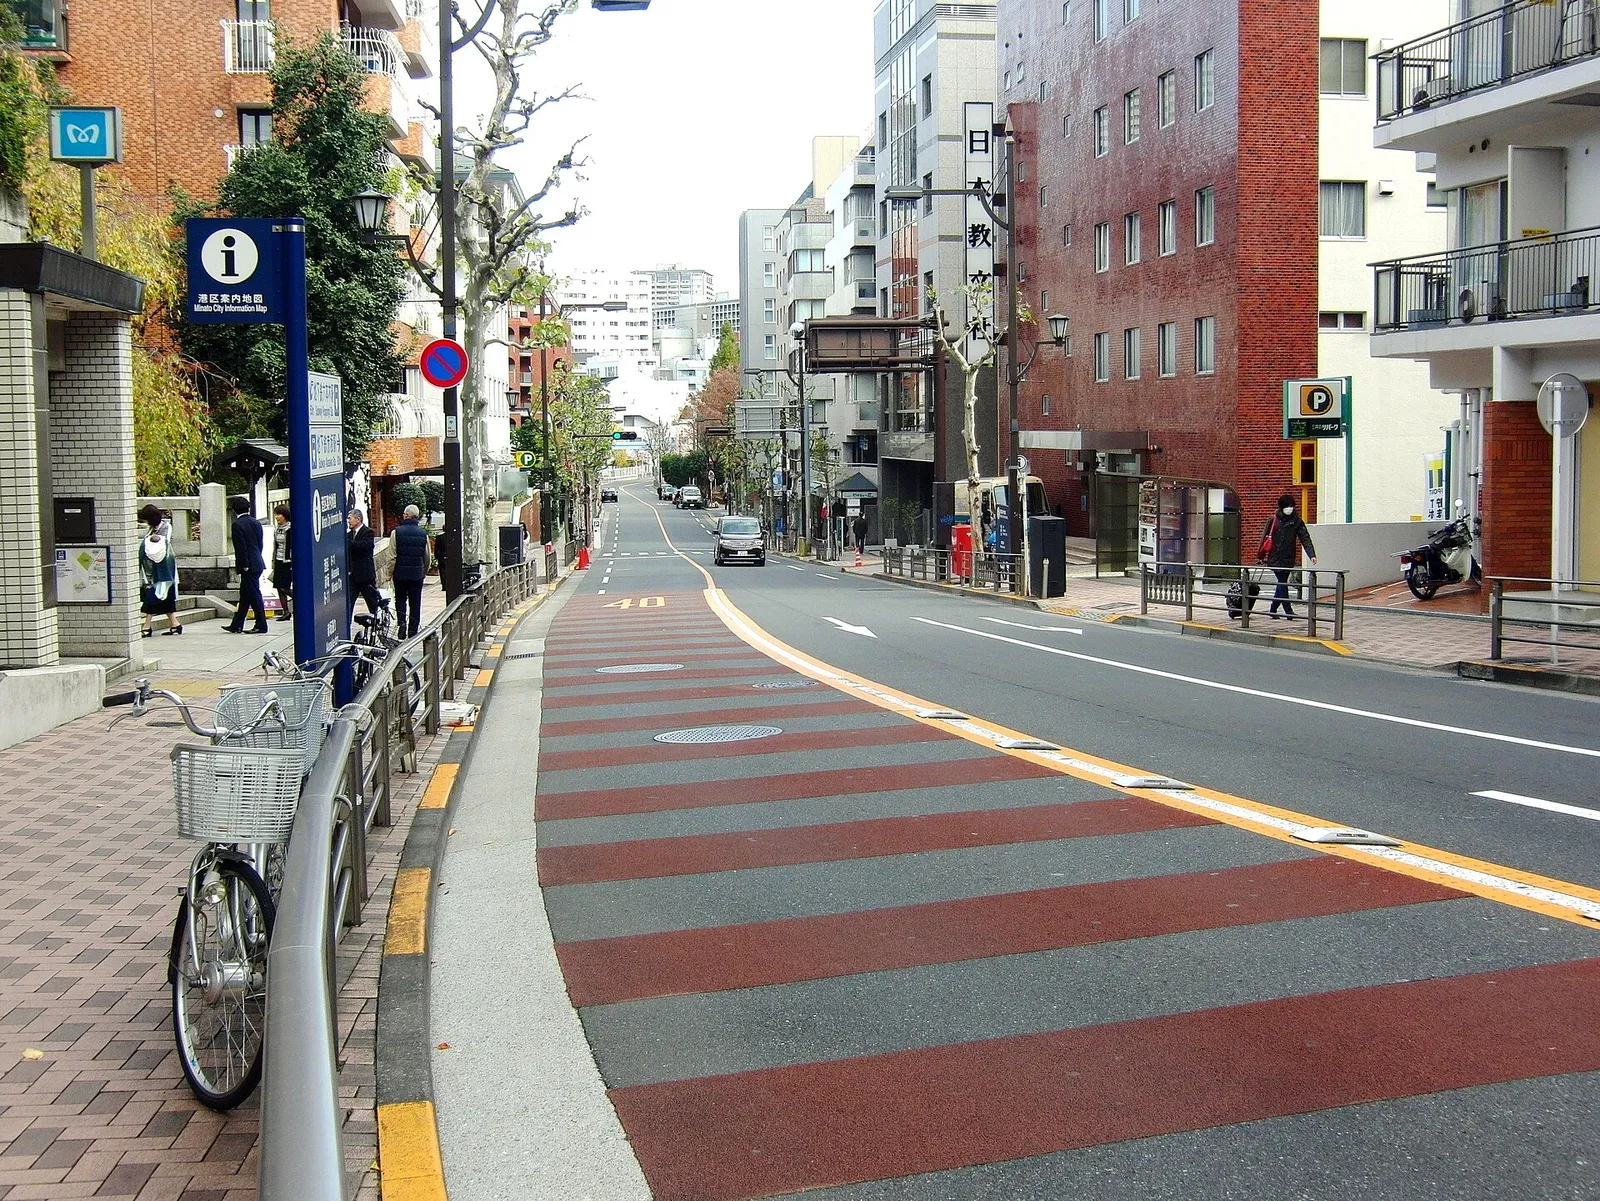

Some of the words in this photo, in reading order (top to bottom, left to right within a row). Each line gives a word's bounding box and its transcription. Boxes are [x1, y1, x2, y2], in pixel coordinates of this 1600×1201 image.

[198, 293, 263, 304] 港区案内地図
[194, 304, 212, 312] Minato
[213, 304, 224, 314] City
[224, 304, 255, 312] Information
[256, 304, 268, 314] Map
[1313, 391, 1327, 410] P
[524, 454, 533, 465] P
[602, 596, 665, 609] 40
